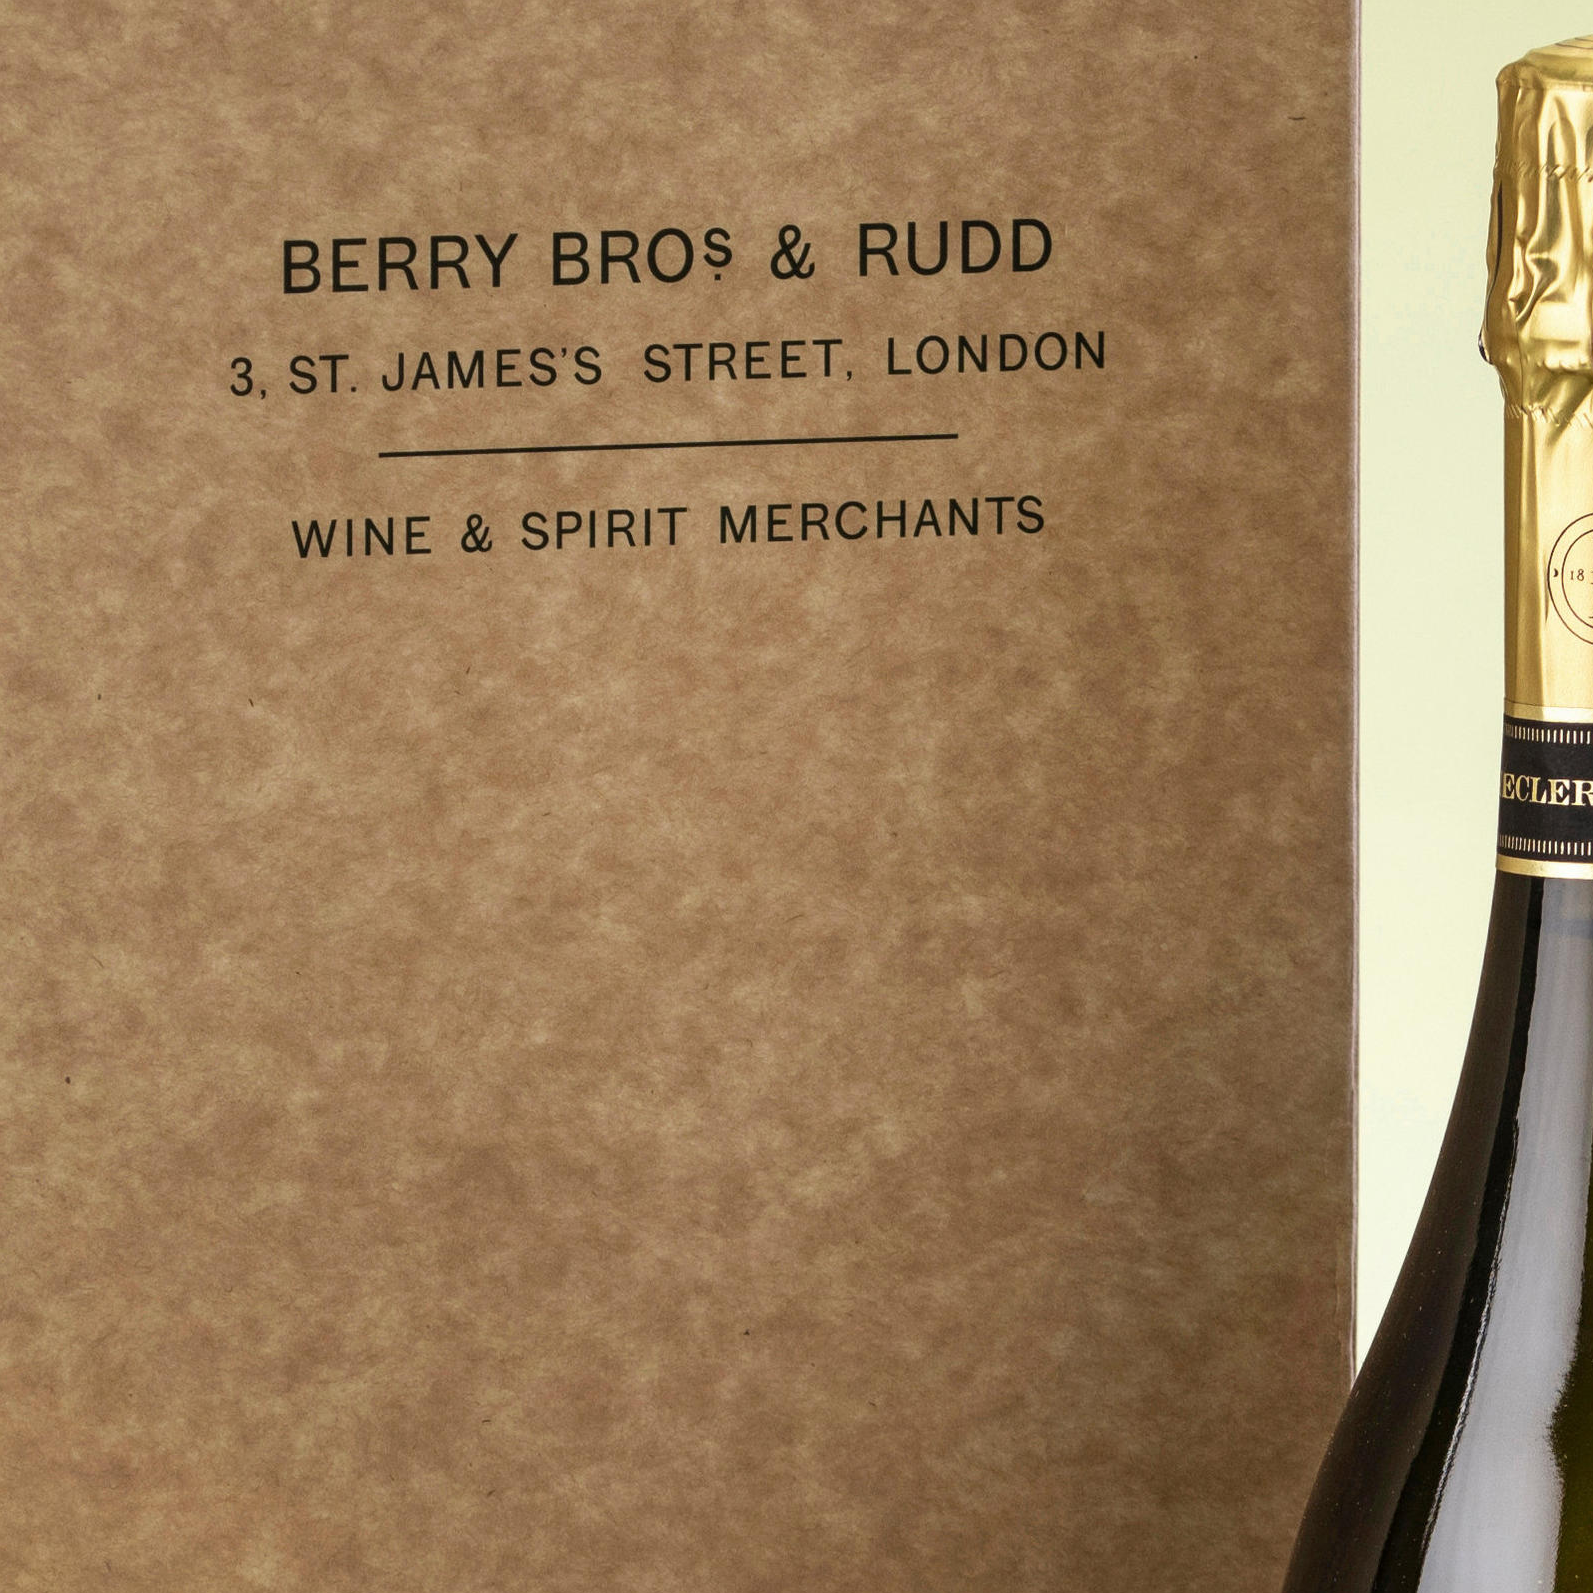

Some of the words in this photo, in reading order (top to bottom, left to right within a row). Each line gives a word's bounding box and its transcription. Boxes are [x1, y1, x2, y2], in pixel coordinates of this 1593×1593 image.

[282, 232, 518, 294] BERRY
[770, 224, 816, 280] &
[858, 217, 1054, 278] RUDD
[229, 356, 267, 401] 3,
[289, 353, 357, 396] ST.
[381, 344, 603, 394] JAMES'S
[642, 338, 855, 384] STREET,
[886, 329, 1107, 377] LONDON
[291, 515, 432, 559] WINE
[460, 513, 494, 554] &
[520, 507, 689, 552] SPIRIT
[719, 495, 1046, 546] MERCHANTS
